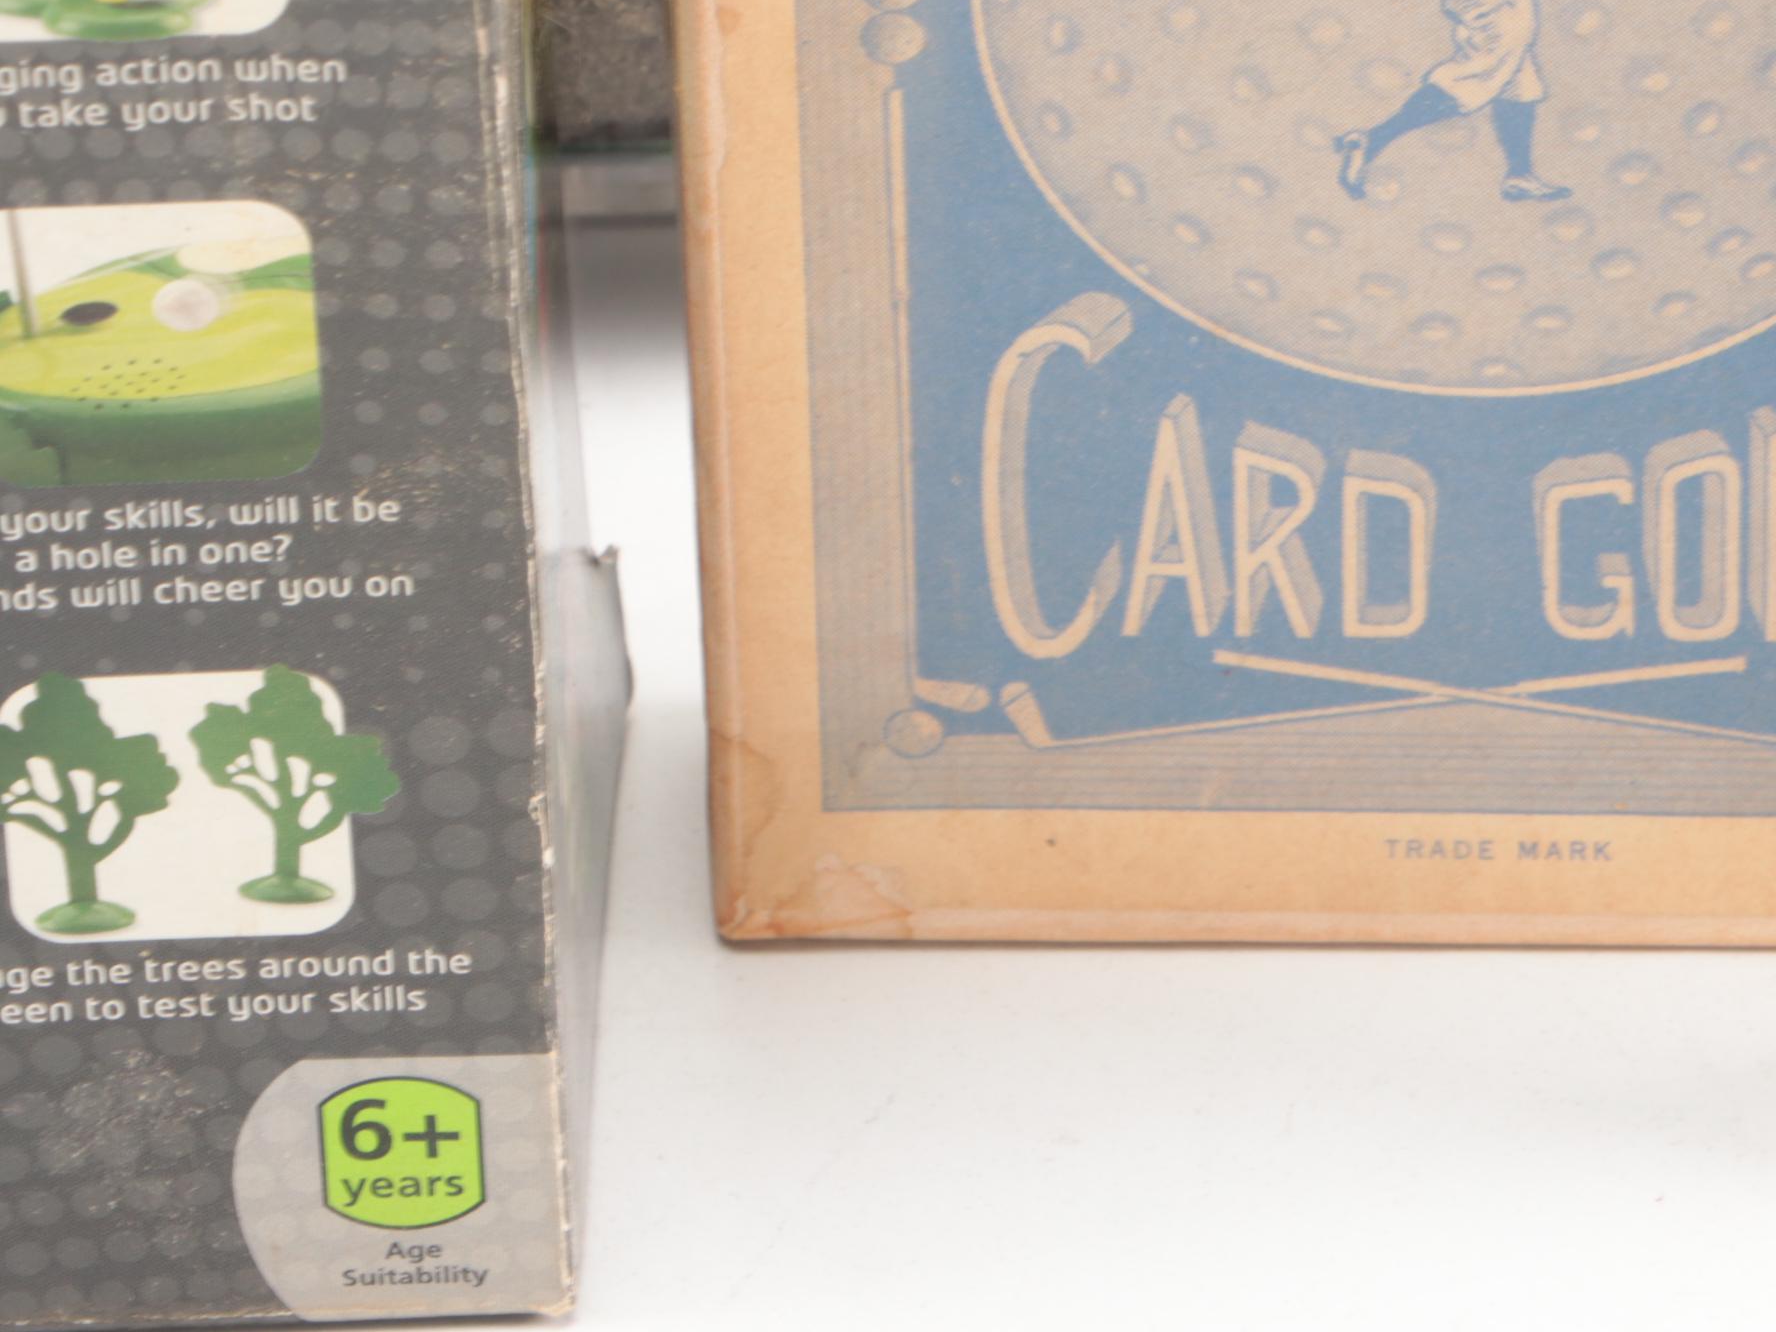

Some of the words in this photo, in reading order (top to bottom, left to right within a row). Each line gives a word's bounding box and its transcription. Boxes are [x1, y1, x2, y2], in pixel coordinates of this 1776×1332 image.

[95, 54, 222, 87] action
[234, 52, 347, 83] when
[18, 98, 108, 128] take
[121, 97, 216, 132] your
[228, 92, 318, 122] shot
[981, 290, 1438, 659] CARD
[0, 507, 91, 542] your
[104, 499, 218, 531] skills,
[229, 494, 298, 526] will
[312, 494, 341, 523] it
[353, 495, 400, 523] be
[15, 549, 38, 573] a
[50, 540, 138, 570] hole
[150, 538, 186, 566] in
[200, 534, 292, 564] one?
[70, 578, 140, 608] will
[153, 576, 267, 606] cheer
[278, 575, 352, 607] you
[364, 573, 414, 599] on
[1384, 837, 1495, 861] TRADE
[1516, 840, 1613, 861] MARK
[0, 965, 55, 995] ge
[65, 959, 131, 987] the
[144, 956, 246, 982] trees
[258, 950, 394, 980] around
[407, 948, 473, 976] the
[0, 1000, 73, 1024] een
[85, 996, 125, 1021] to
[138, 992, 216, 1019] test
[227, 990, 316, 1022] your
[329, 984, 427, 1013] skills
[339, 1098, 460, 1161] 6+
[341, 1175, 465, 1207] years
[385, 1241, 443, 1263] Age
[341, 1267, 488, 1288] Suitability
